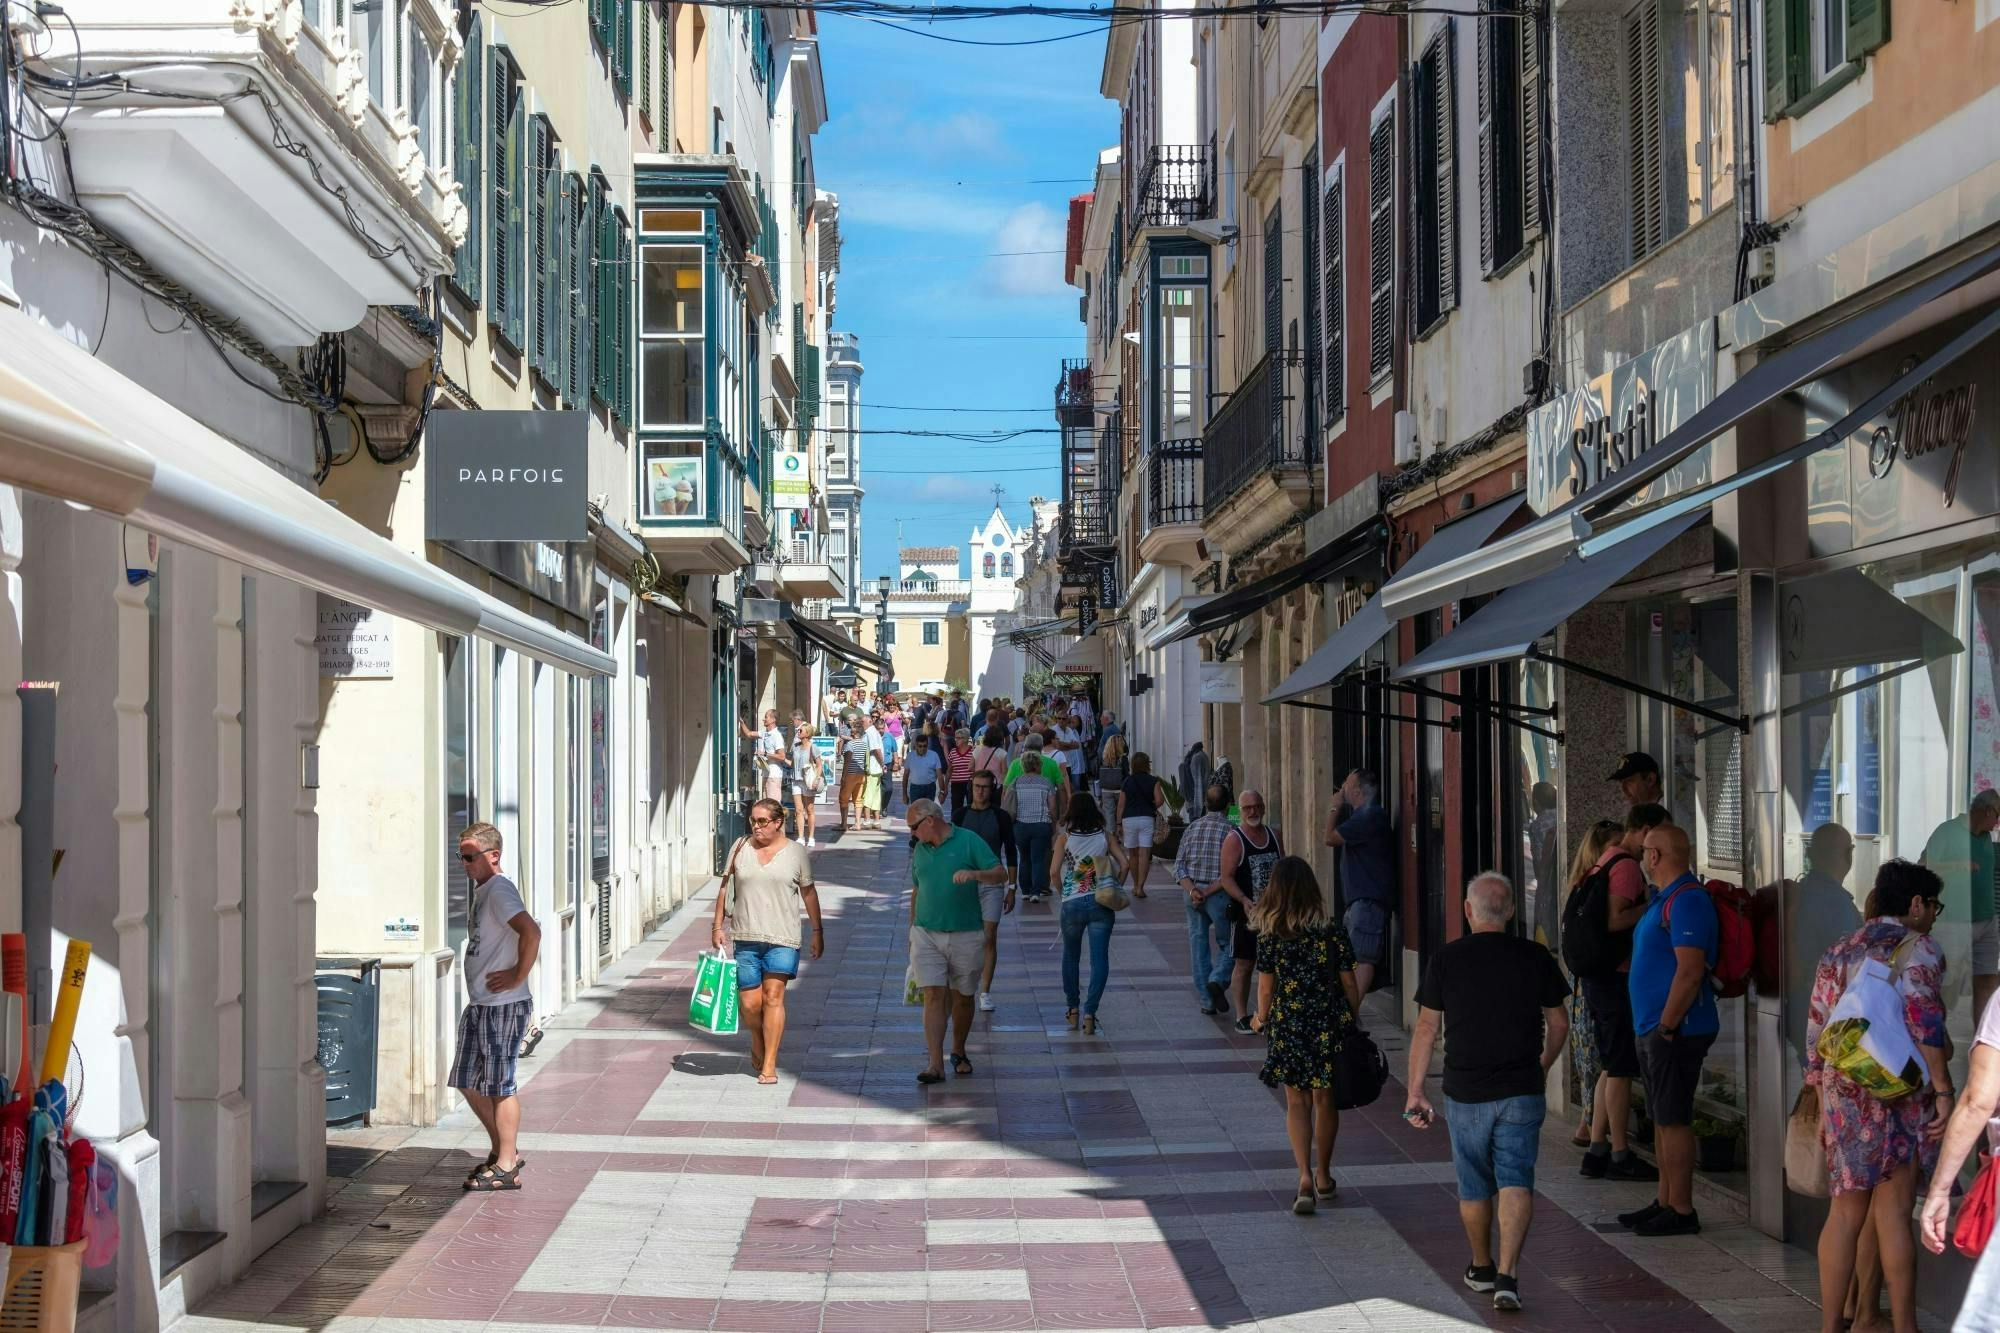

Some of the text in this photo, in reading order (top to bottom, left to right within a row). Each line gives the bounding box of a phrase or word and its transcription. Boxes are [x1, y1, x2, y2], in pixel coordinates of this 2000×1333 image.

[1570, 389, 1657, 497] S'Estil
[459, 468, 564, 483] PARFOIS
[1102, 567, 1112, 605] MANGO
[356, 661, 390, 669] 1842-1919
